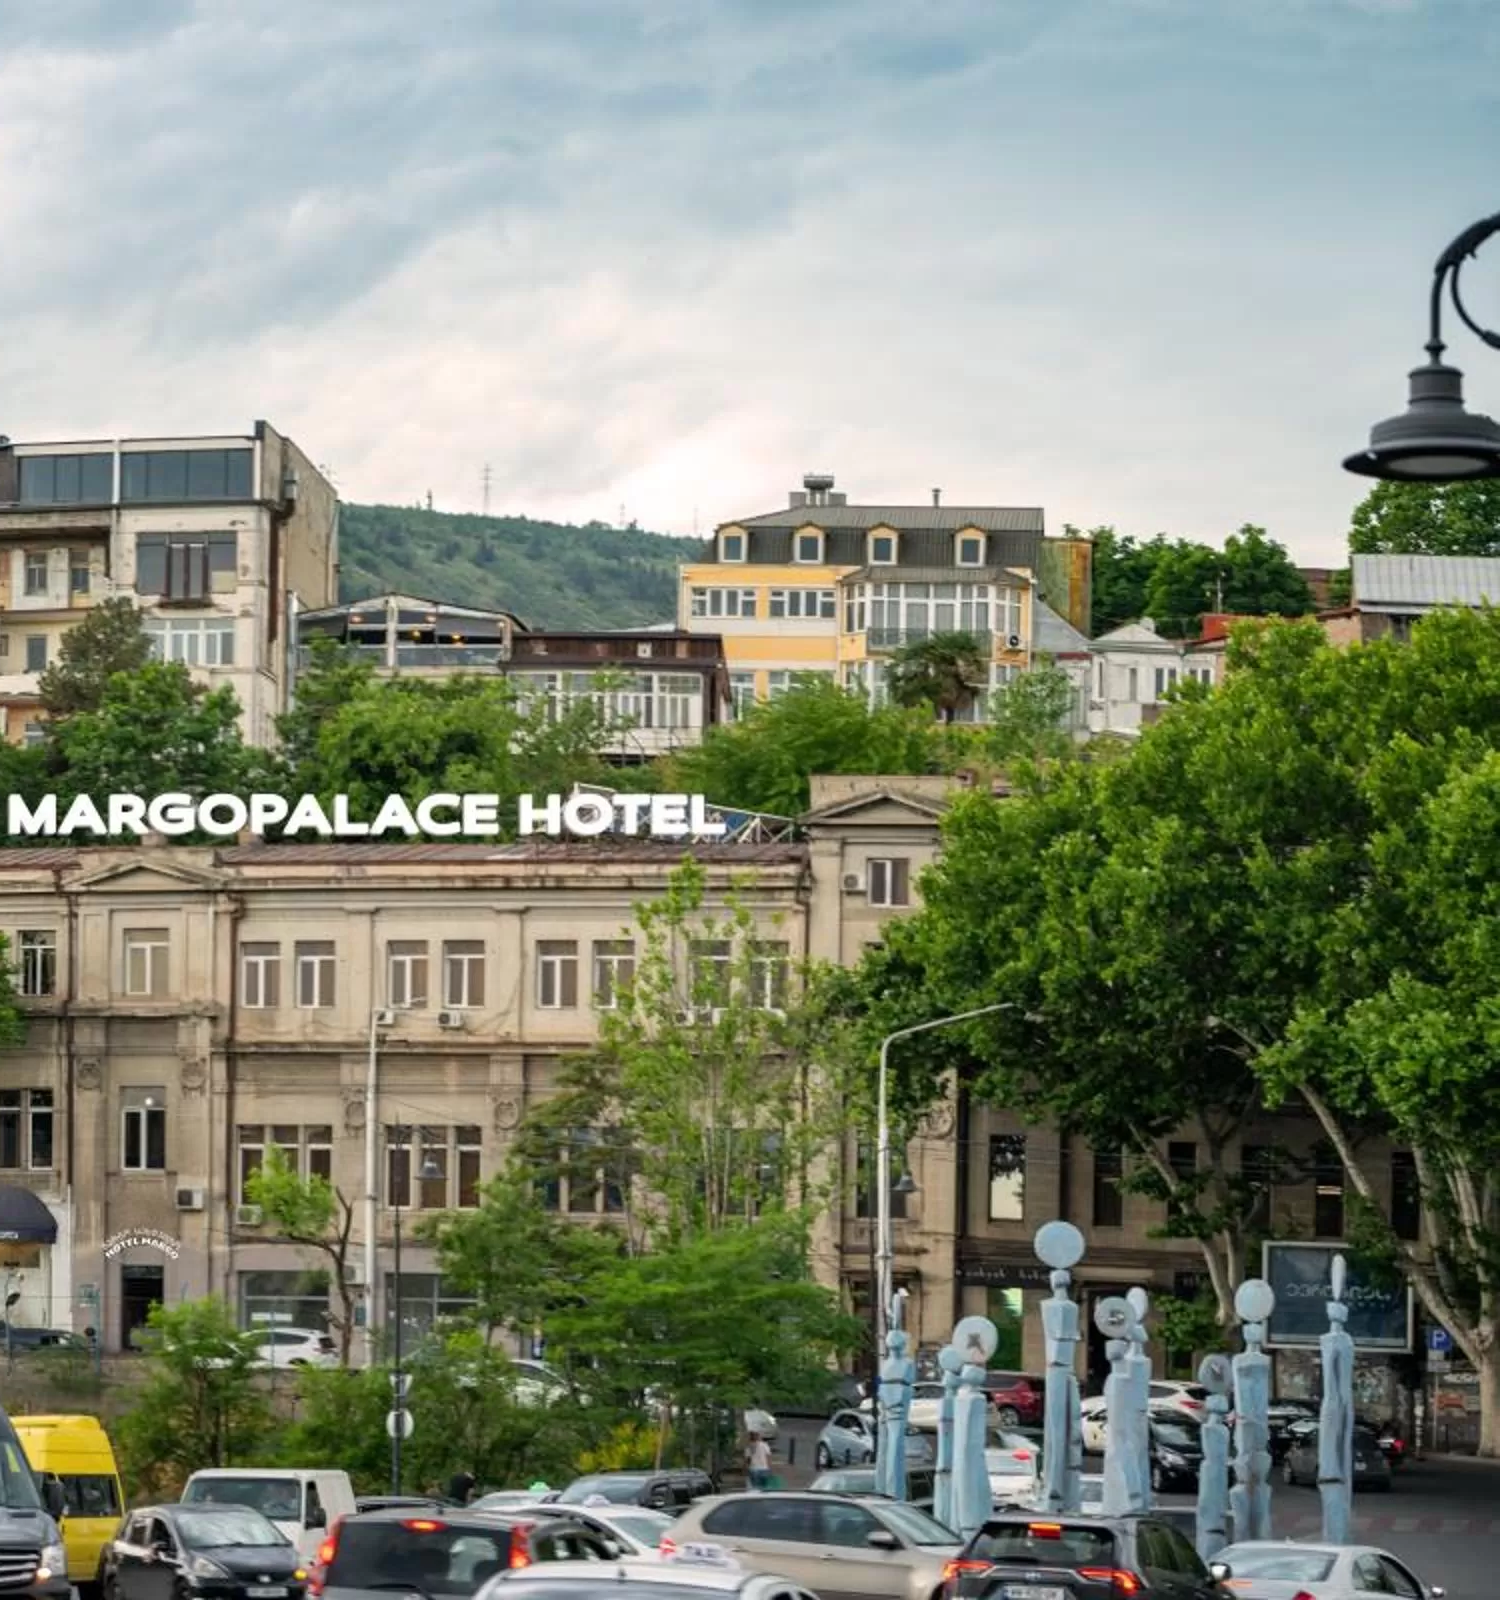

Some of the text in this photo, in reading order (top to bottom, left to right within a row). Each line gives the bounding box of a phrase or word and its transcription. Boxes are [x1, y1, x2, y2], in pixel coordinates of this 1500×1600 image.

[8, 793, 726, 836] MARGOPALACE HOTEL
[105, 1237, 179, 1260] HOTEL MARGO
[1432, 1329, 1445, 1348] P
